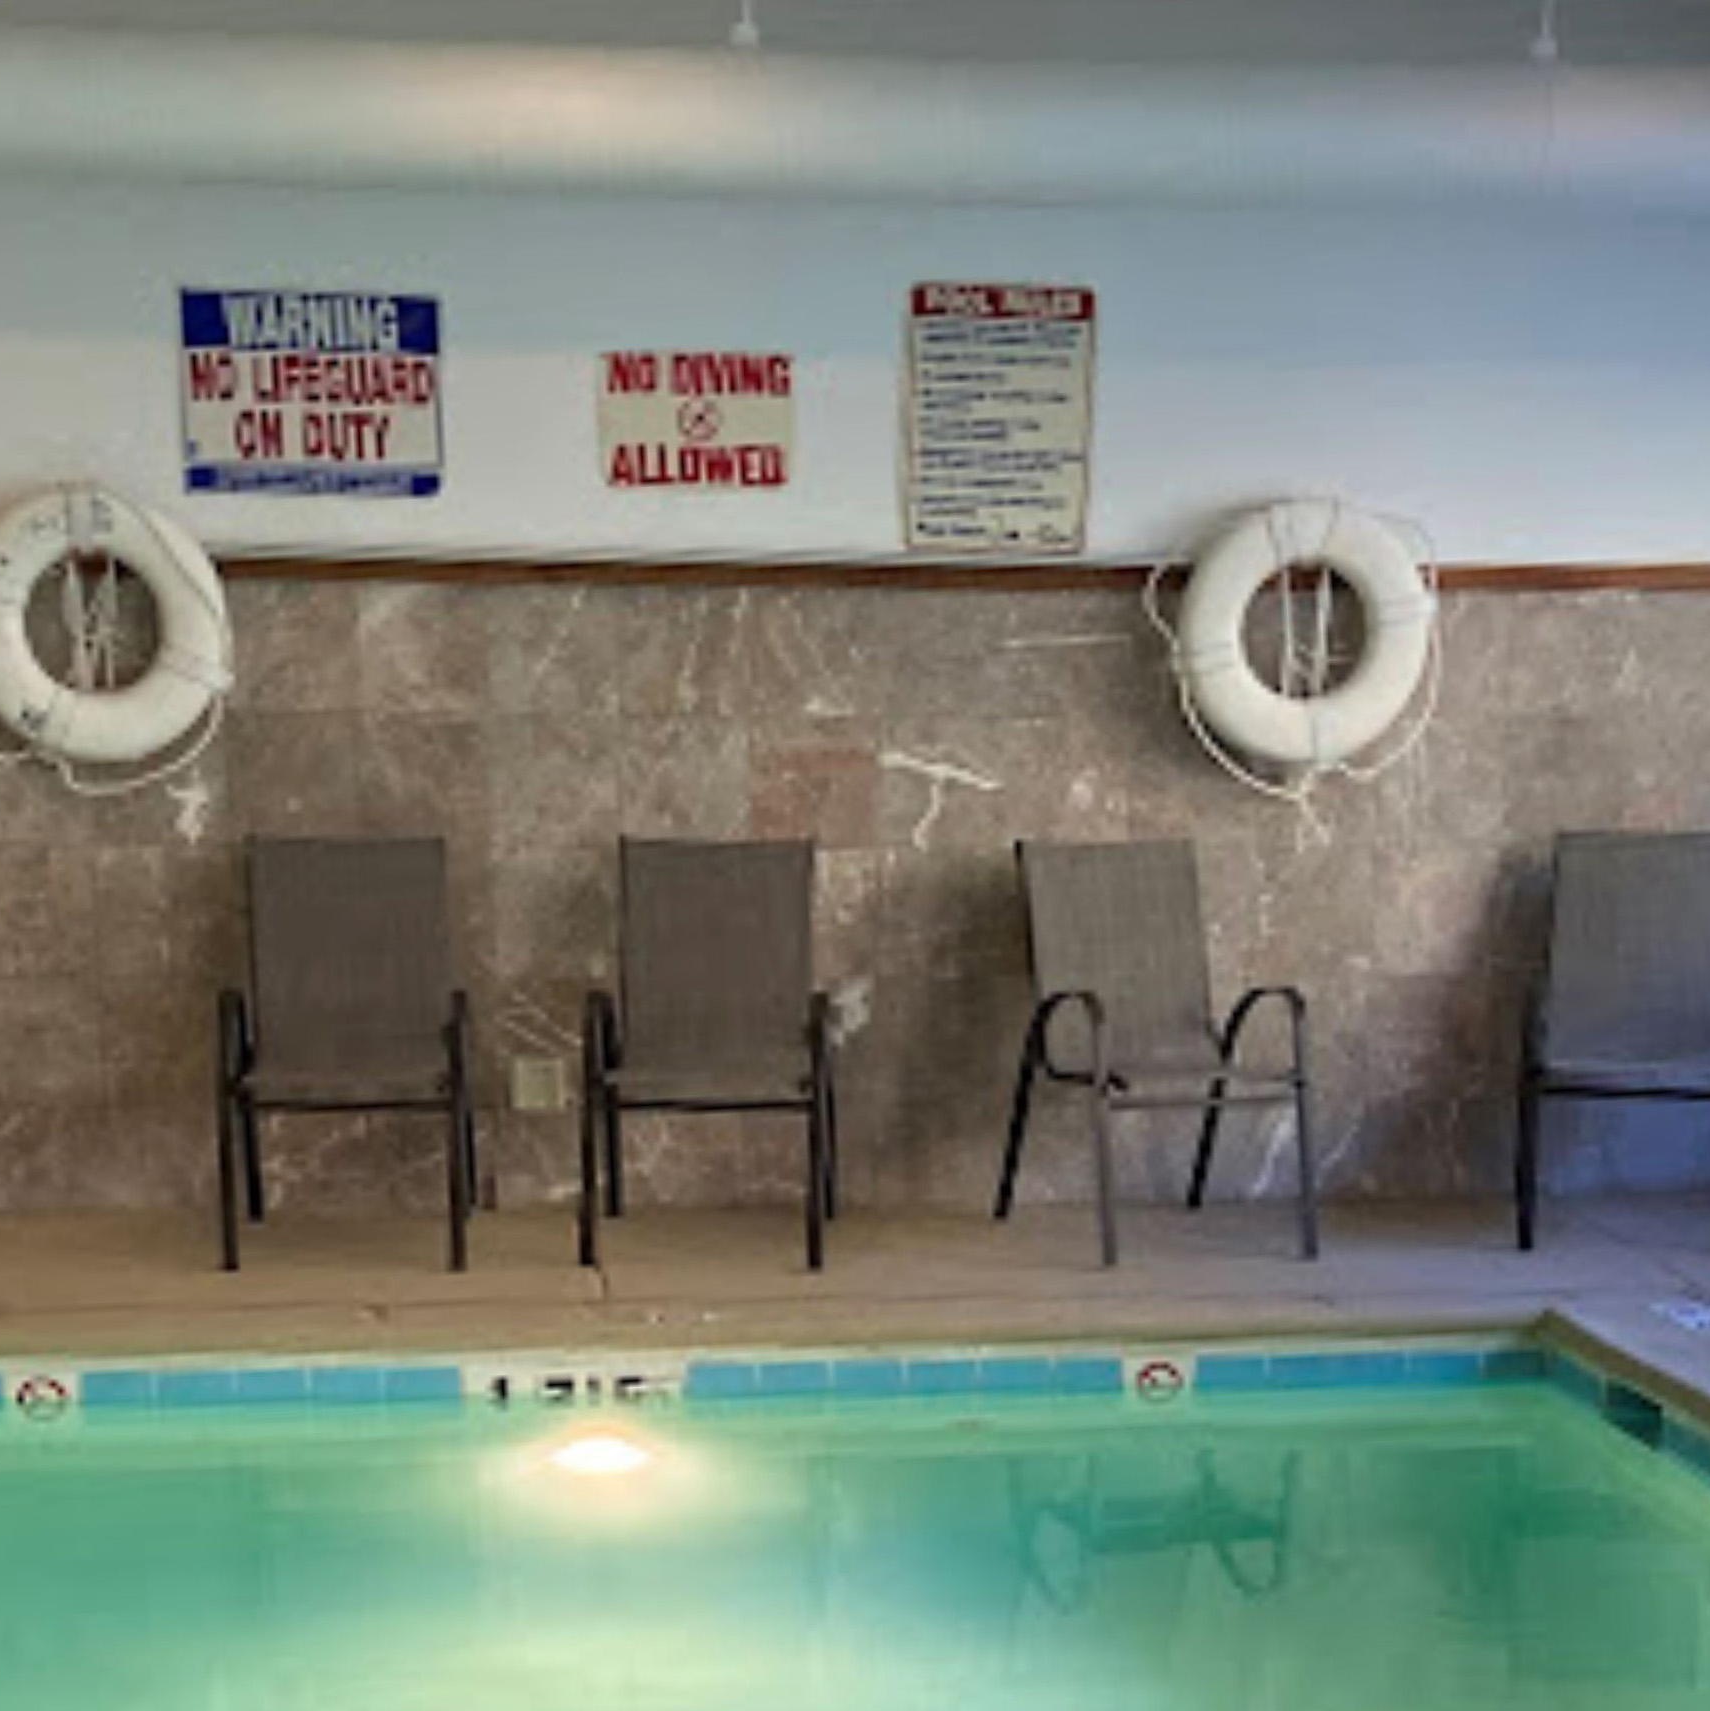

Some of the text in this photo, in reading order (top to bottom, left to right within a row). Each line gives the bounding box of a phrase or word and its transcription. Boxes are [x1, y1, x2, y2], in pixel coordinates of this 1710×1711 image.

[222, 292, 398, 350] WARNING
[190, 352, 436, 405] NO LIFEGUARD
[604, 351, 791, 396] NO DIVING
[236, 408, 391, 462] ON DUTY
[606, 442, 786, 487] ALLOWED
